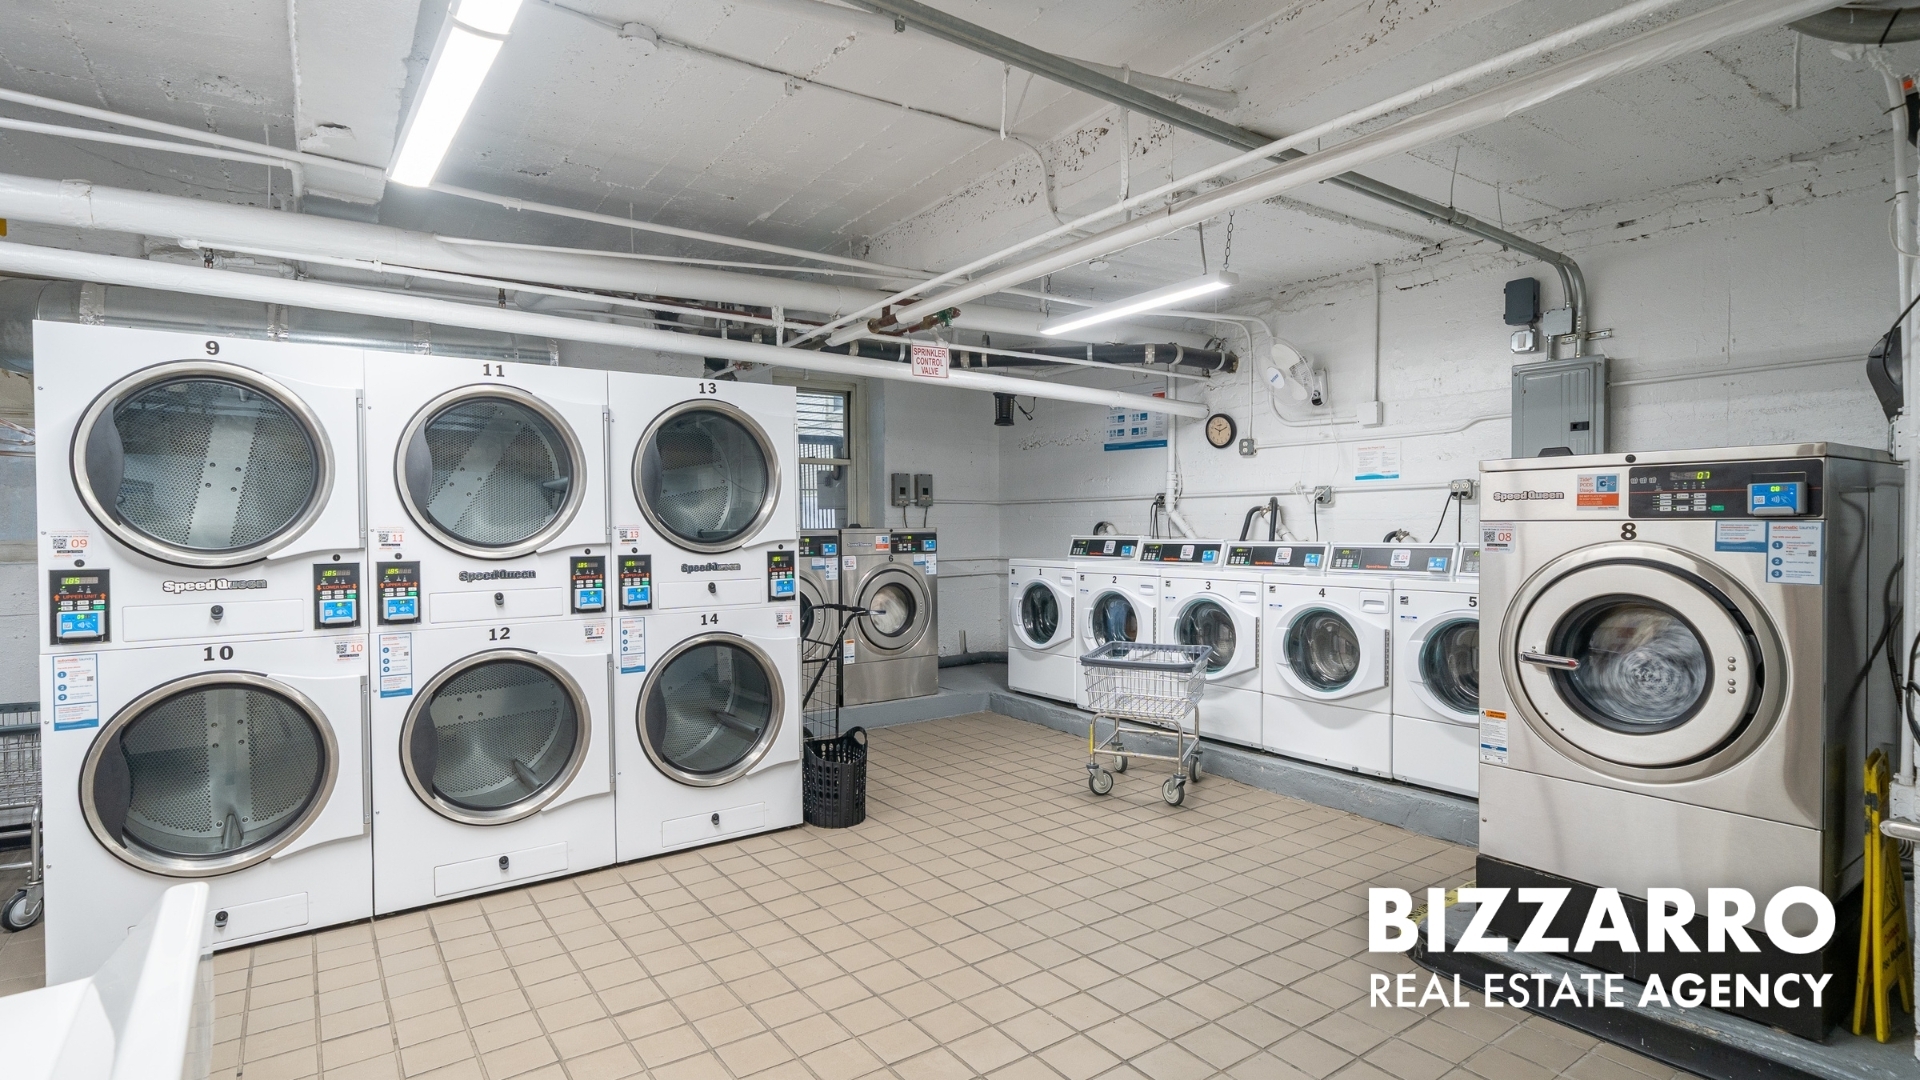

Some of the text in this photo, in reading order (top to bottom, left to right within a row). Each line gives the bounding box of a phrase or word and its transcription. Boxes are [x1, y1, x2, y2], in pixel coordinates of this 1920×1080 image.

[204, 340, 220, 356] 9
[913, 347, 946, 358] SPRINKLER
[916, 357, 944, 367] CONTROL
[482, 363, 506, 378] 11
[921, 366, 938, 376] VALVE
[698, 382, 717, 394] 13
[1697, 472, 1710, 480] 07
[1493, 490, 1564, 502] Speed Queen
[1498, 532, 1512, 542] 08
[1620, 522, 1637, 541] 8
[71, 539, 88, 548] 09
[392, 534, 404, 542] 11
[681, 563, 712, 574] Speed
[459, 569, 536, 583] Speed Queen
[162, 578, 267, 594] Speed Queen
[1206, 581, 1211, 590] 3
[1318, 588, 1326, 598] 4
[1468, 597, 1477, 607] 5
[700, 613, 718, 626] 14
[488, 627, 510, 641] 12
[203, 645, 234, 662] 10
[350, 644, 363, 653] 10
